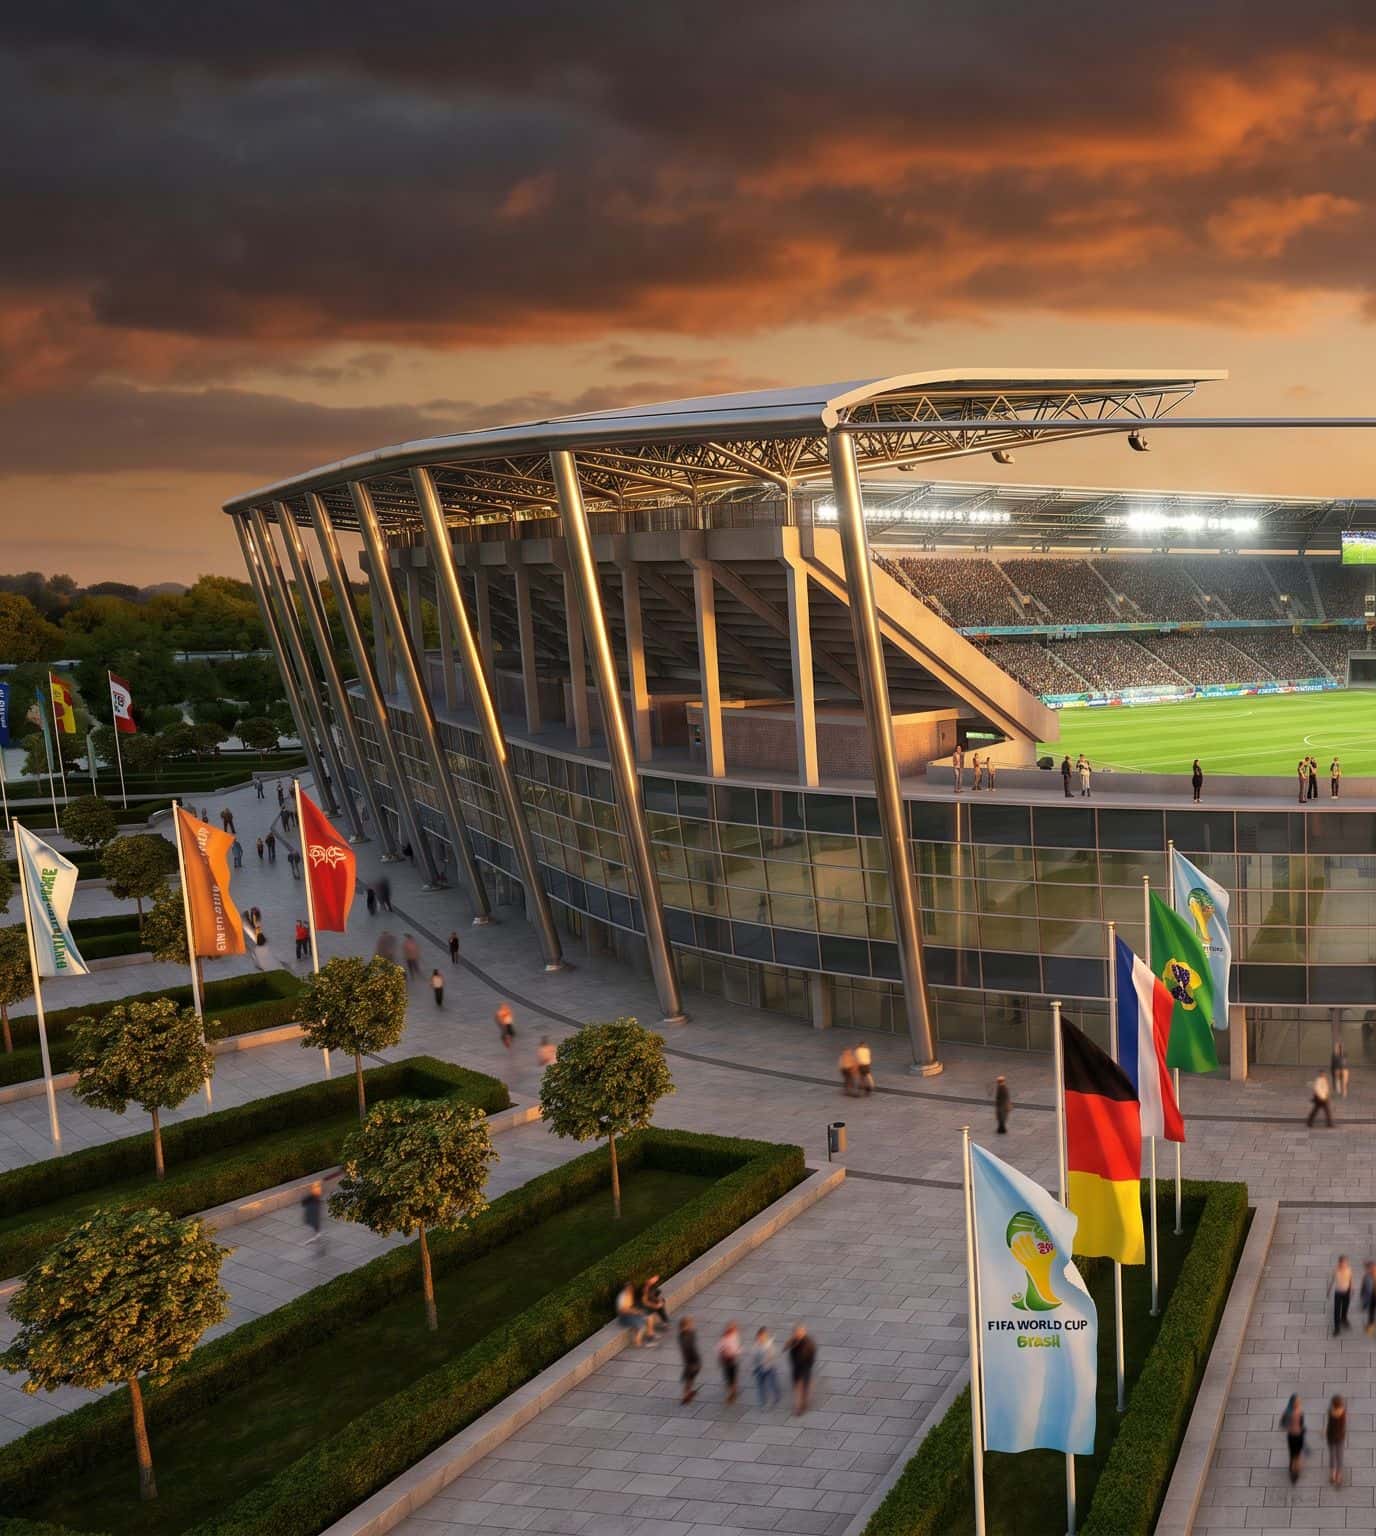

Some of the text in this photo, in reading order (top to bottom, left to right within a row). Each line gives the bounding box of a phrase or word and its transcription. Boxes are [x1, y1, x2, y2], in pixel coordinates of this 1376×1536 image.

[987, 1320, 1088, 1331] FIFA WORLD CUP
